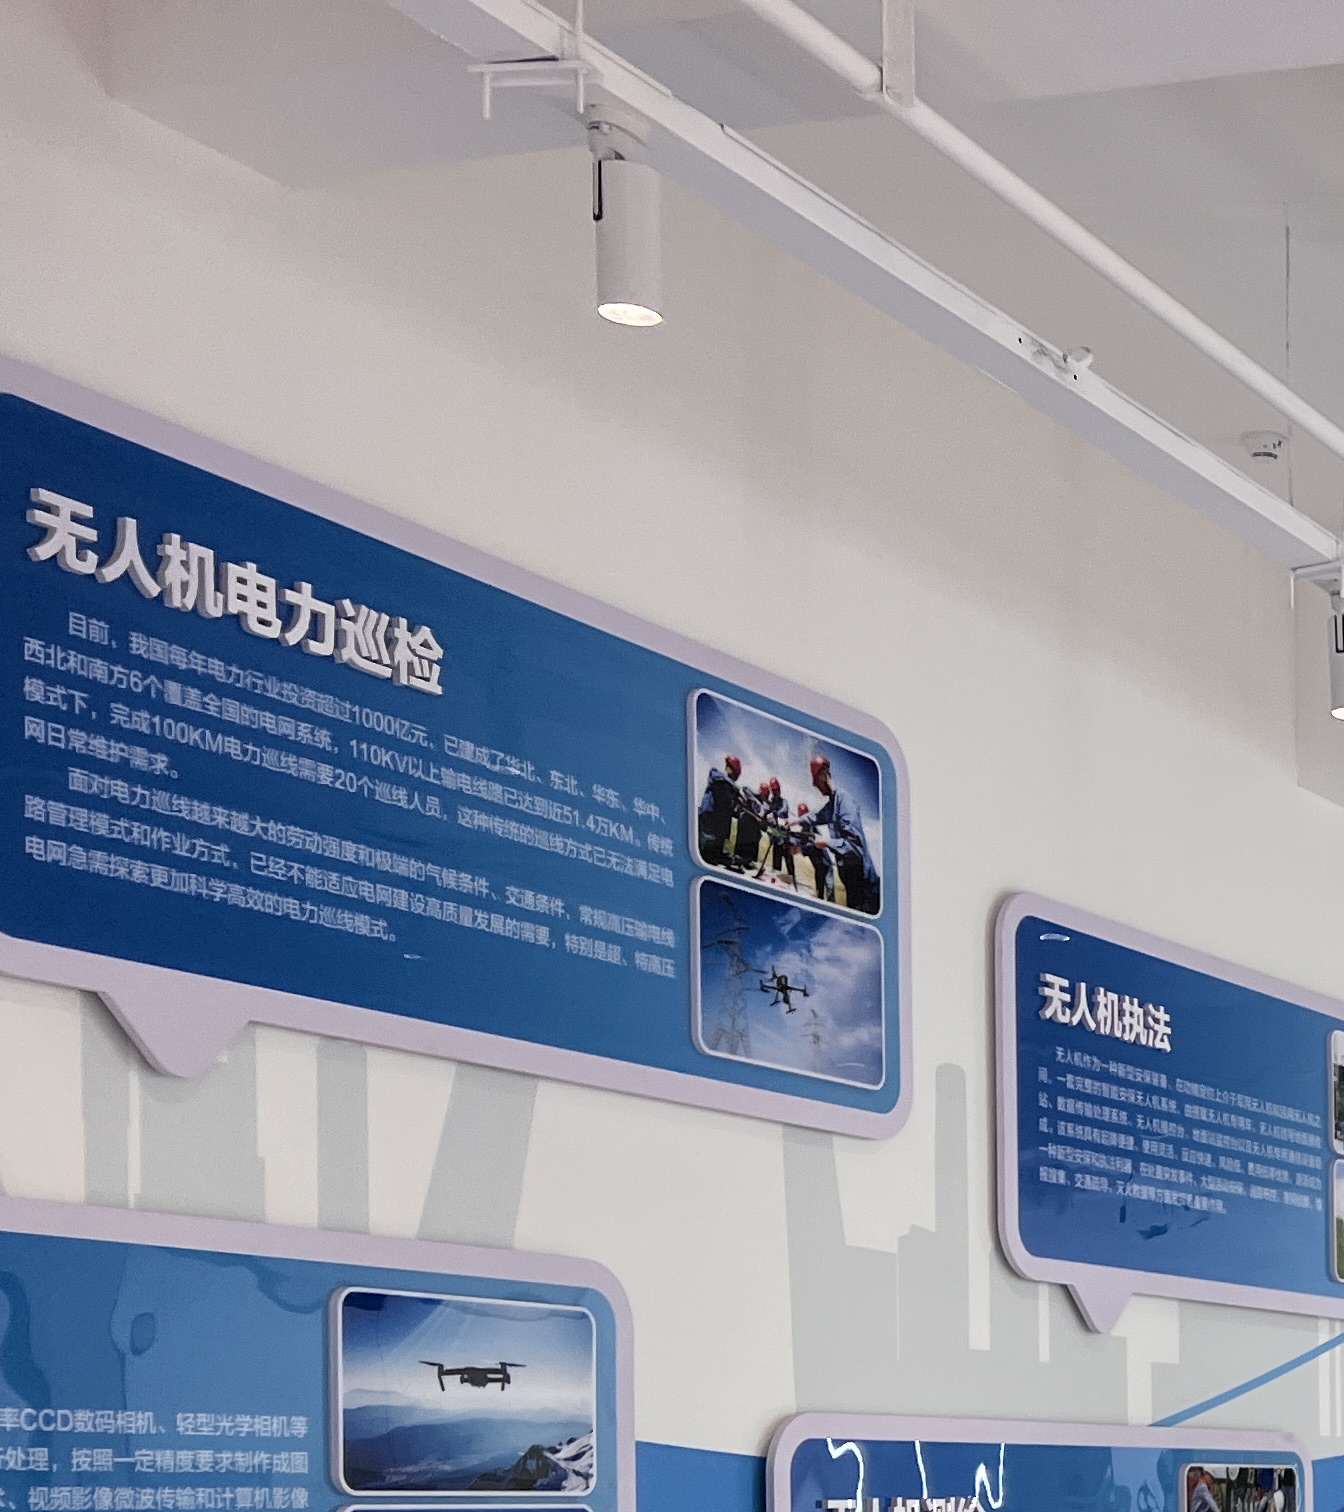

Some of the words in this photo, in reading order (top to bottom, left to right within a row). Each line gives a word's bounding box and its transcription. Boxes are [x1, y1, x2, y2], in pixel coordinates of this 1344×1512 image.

[26, 487, 445, 696] 无人机电力巡检
[24, 715, 181, 780] 网日常维护需求。
[1038, 972, 1171, 1053] 无人机执法
[0, 1447, 309, 1474] 处理，按照一定精度要求制作成图
[0, 1486, 309, 1510] 、视频影像微波传输和计算机影像
